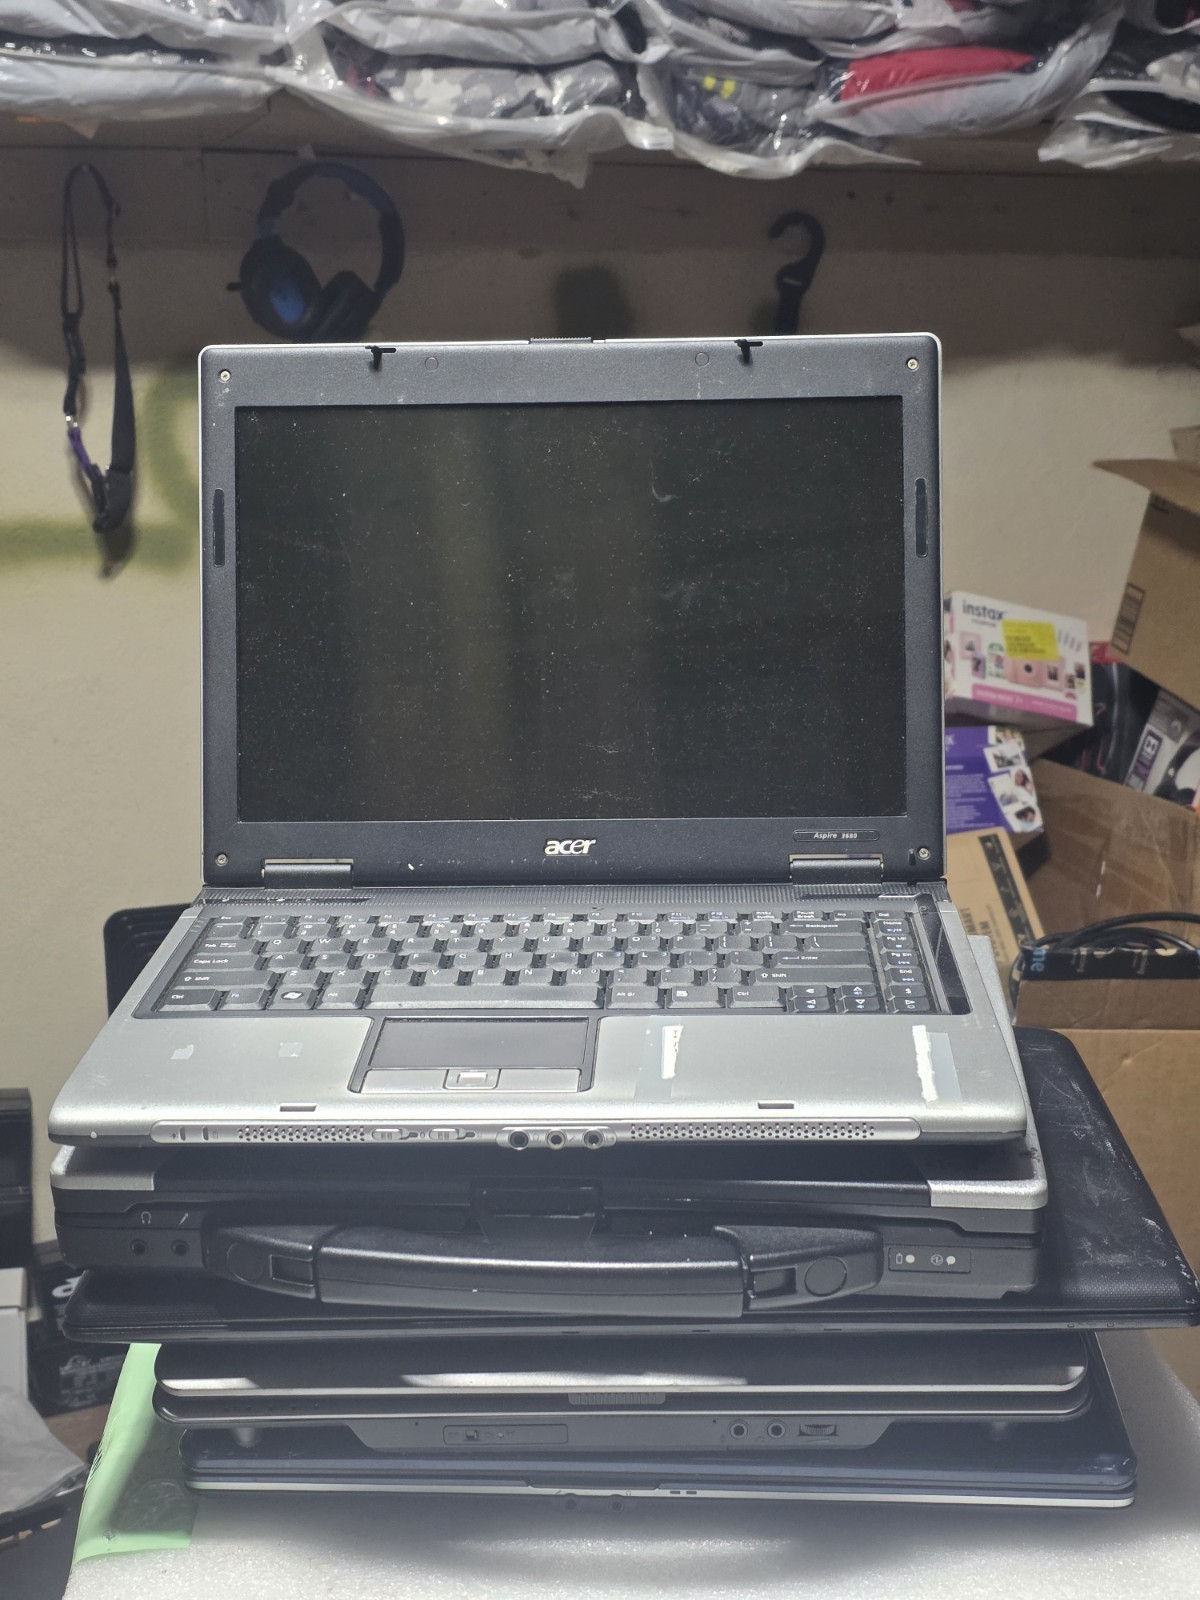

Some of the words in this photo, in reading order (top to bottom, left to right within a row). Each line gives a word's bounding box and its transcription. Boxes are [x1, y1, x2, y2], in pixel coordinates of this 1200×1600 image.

[962, 599, 1005, 621] instax
[813, 832, 838, 840] Aspire
[544, 839, 597, 855] acer
